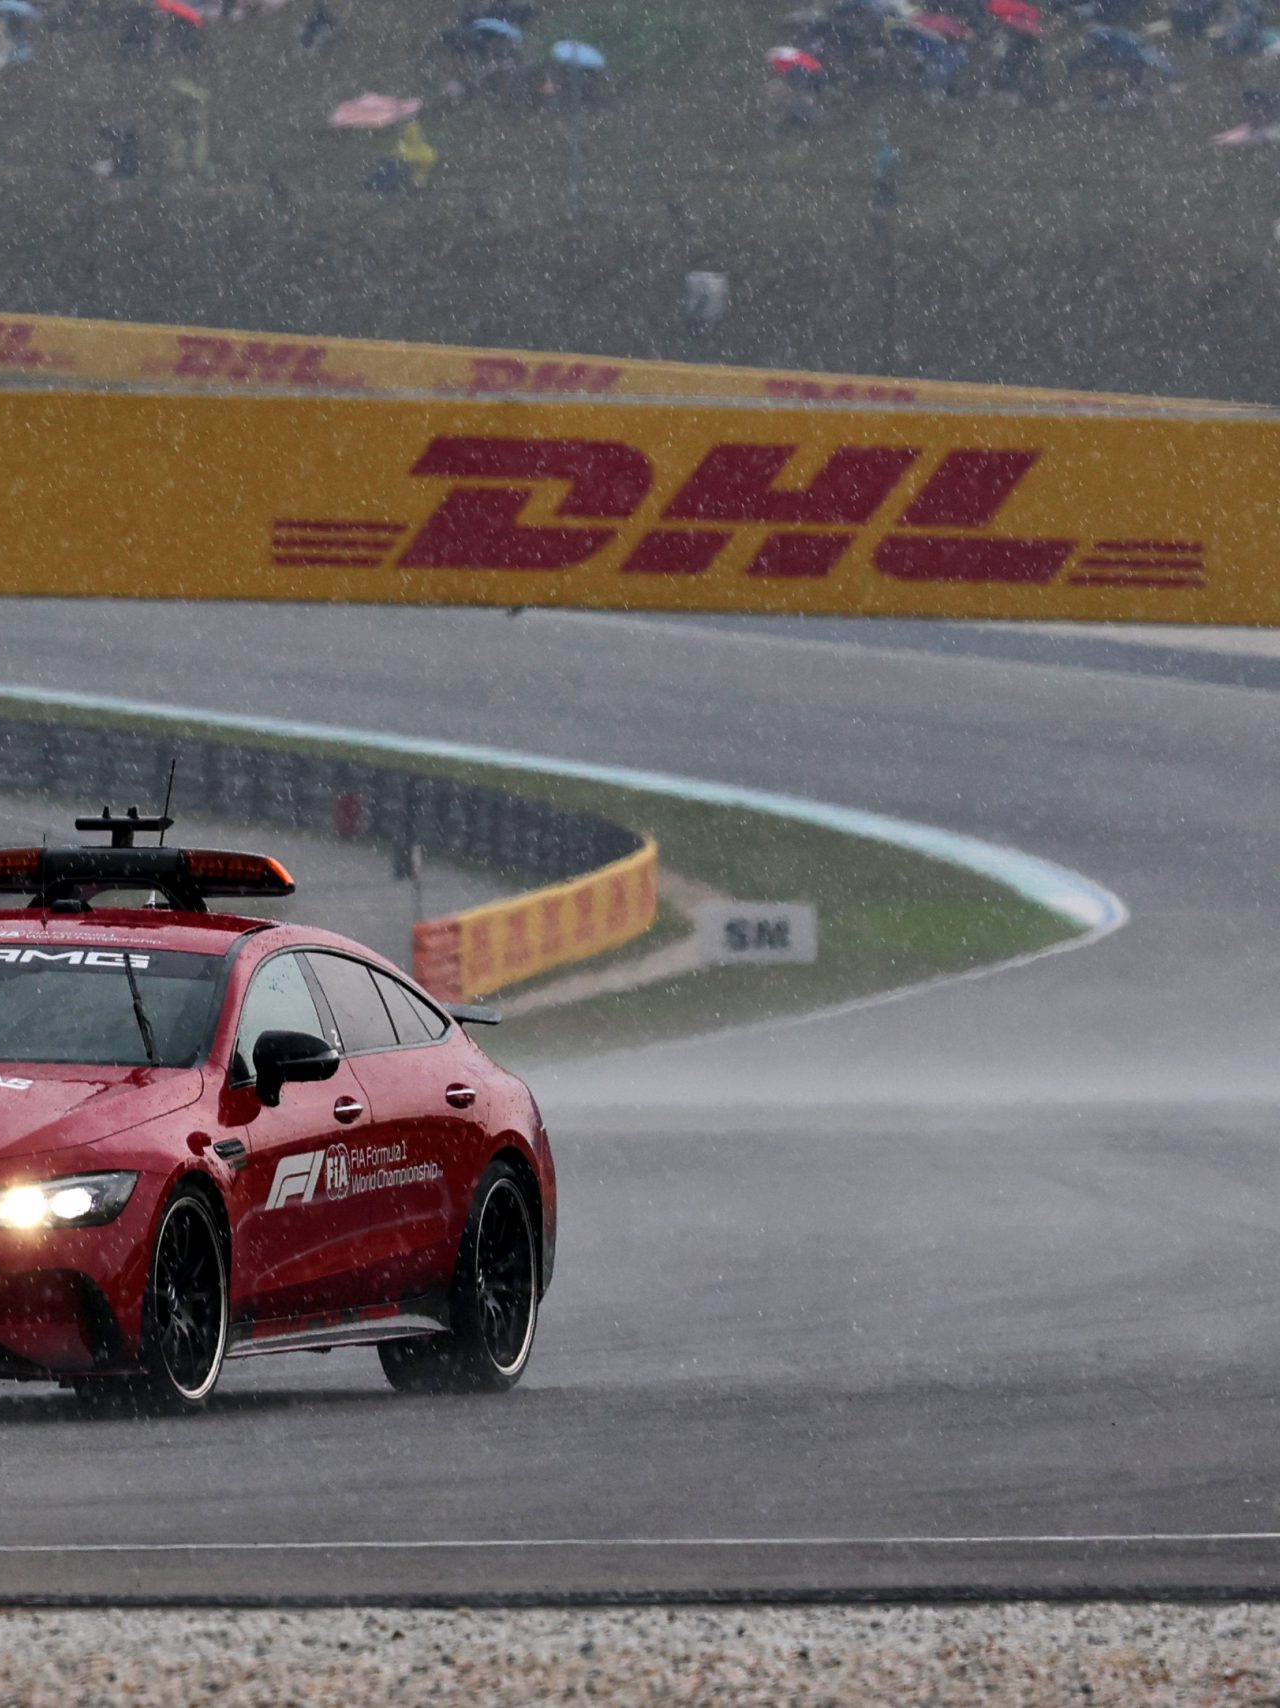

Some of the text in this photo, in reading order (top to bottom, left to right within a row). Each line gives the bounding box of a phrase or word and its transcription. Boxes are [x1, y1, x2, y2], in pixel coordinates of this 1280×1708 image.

[394, 435, 1077, 582] DHL
[725, 916, 790, 952] SM
[350, 1139, 408, 1169] FIA Formula 1
[351, 1159, 438, 1195] World Championship
